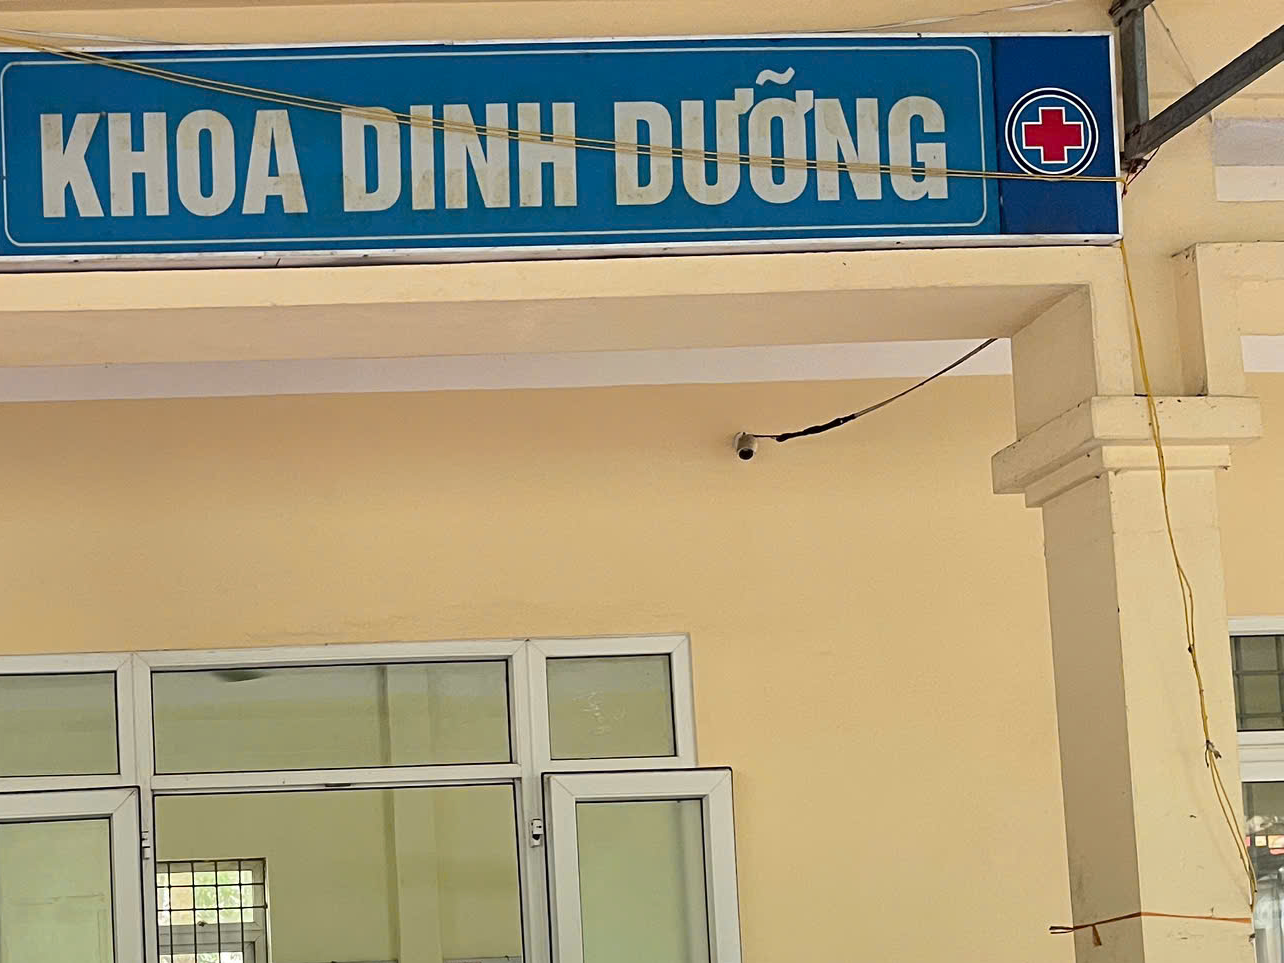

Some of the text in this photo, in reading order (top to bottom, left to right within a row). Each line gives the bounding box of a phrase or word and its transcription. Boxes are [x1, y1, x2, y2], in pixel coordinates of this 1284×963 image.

[40, 67, 948, 218] KHOA DINH DƯỠNG
